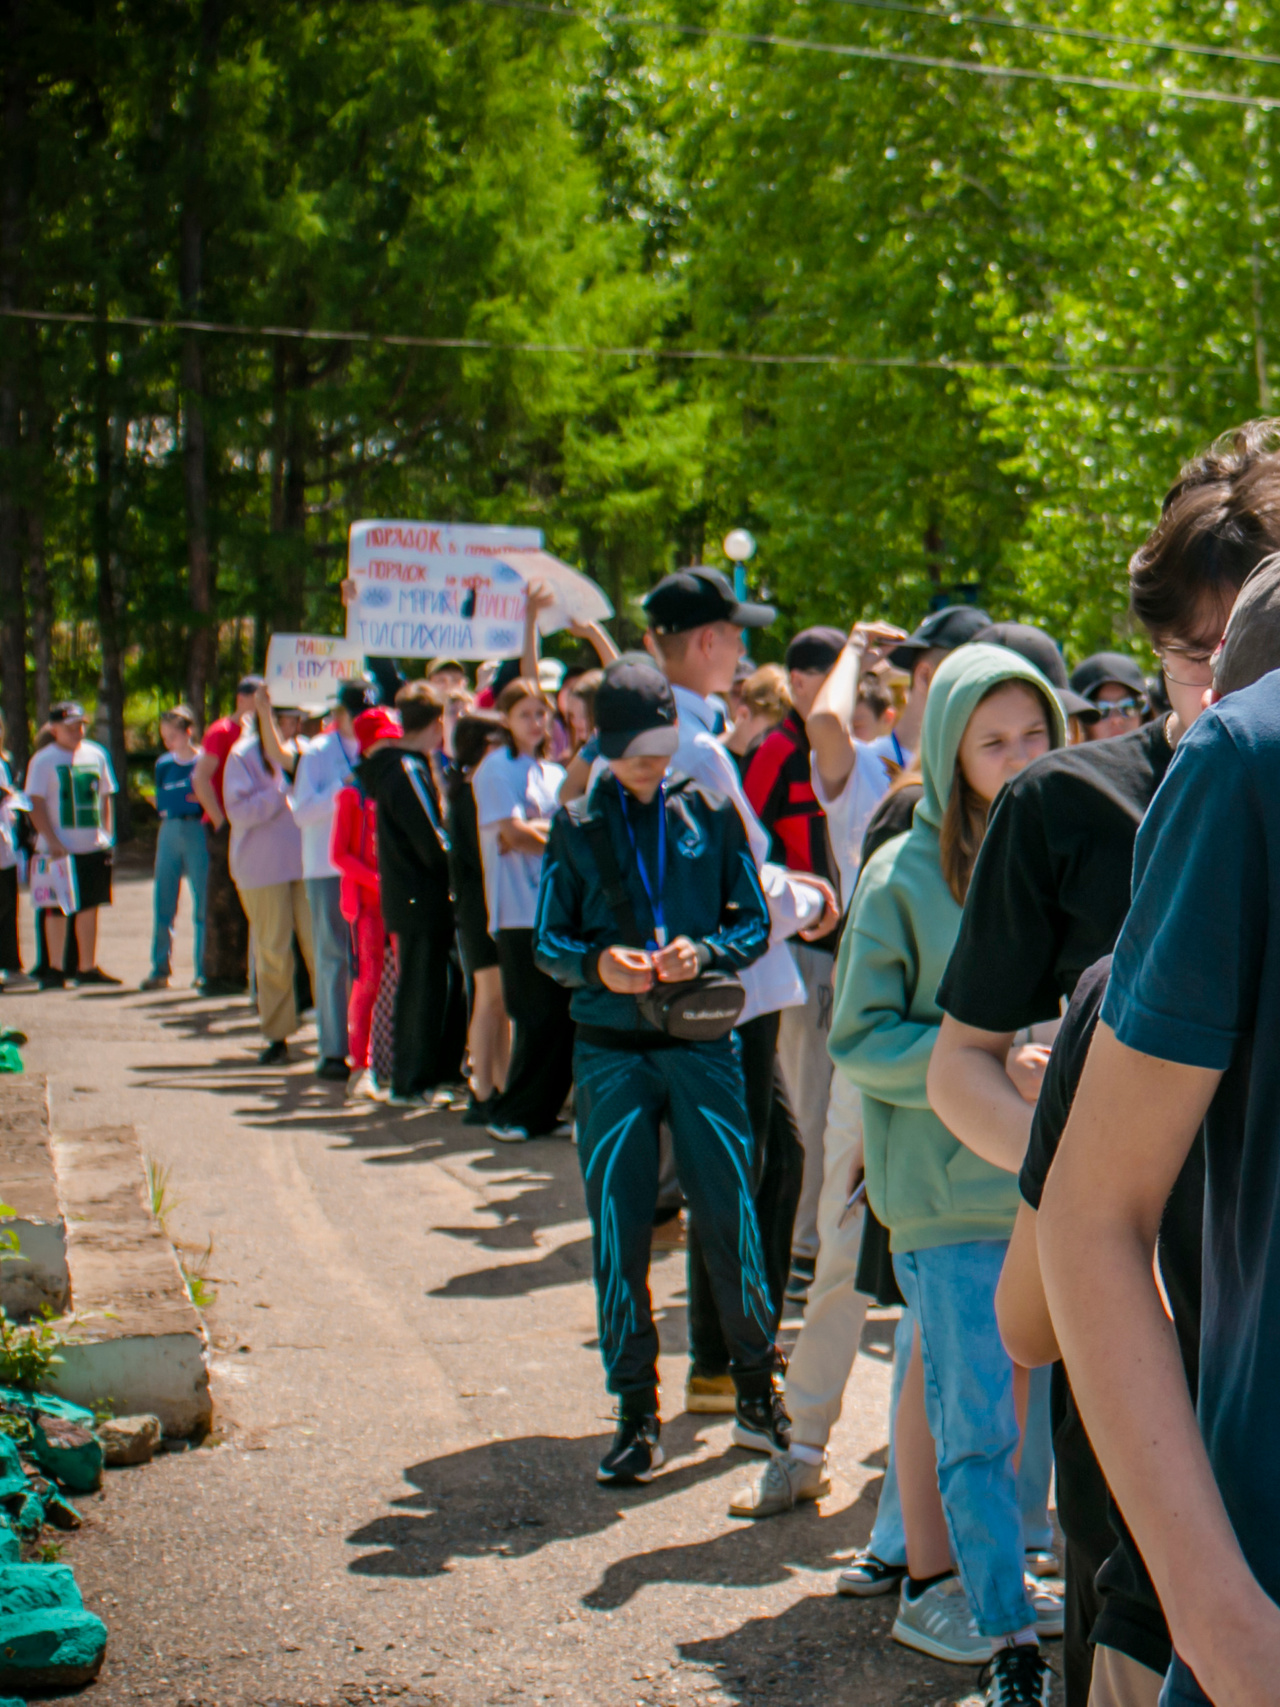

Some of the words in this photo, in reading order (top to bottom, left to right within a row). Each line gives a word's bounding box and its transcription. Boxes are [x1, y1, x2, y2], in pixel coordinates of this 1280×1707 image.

[365, 527, 442, 554] ПОРЯДОК
[368, 559, 427, 582] ПОРЯДОК
[358, 620, 474, 649] ТОЛСТИХИНА
